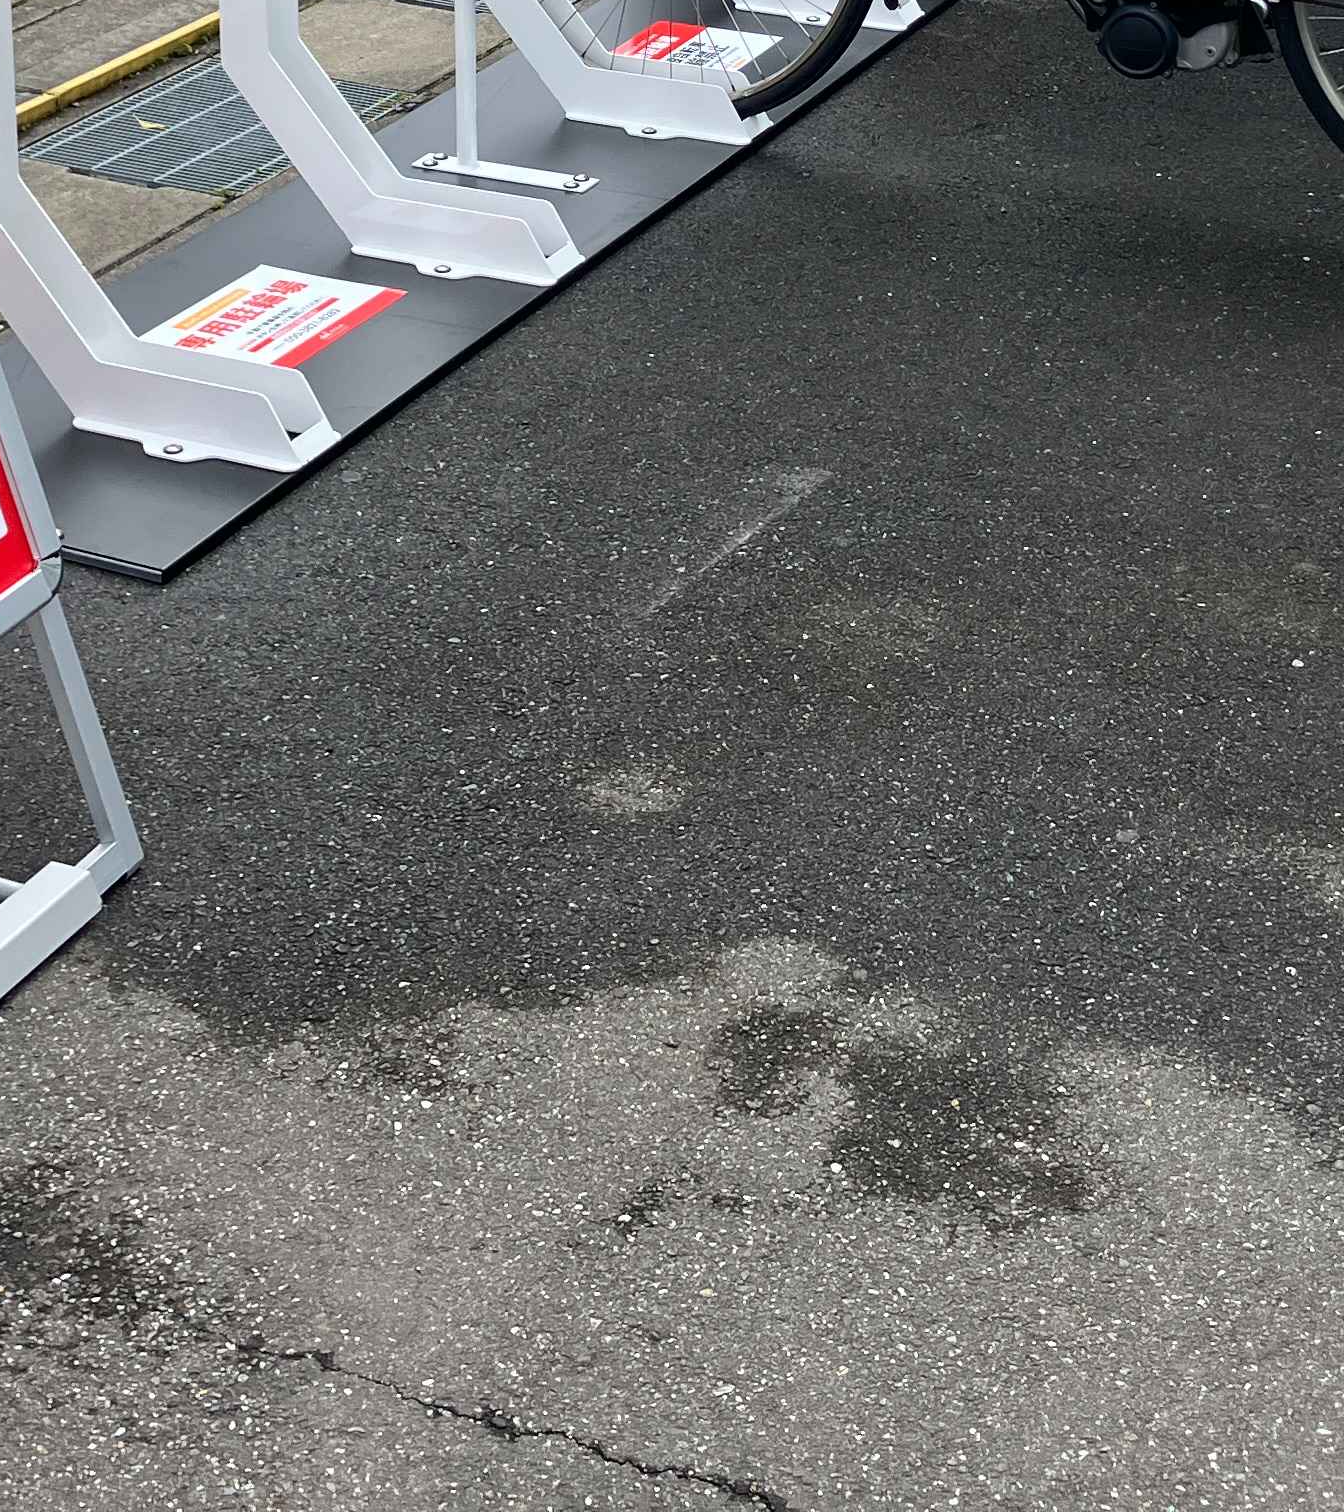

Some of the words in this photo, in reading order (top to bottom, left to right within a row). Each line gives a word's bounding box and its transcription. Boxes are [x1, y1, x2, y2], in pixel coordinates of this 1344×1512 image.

[174, 279, 309, 351] 専用駐輪場
